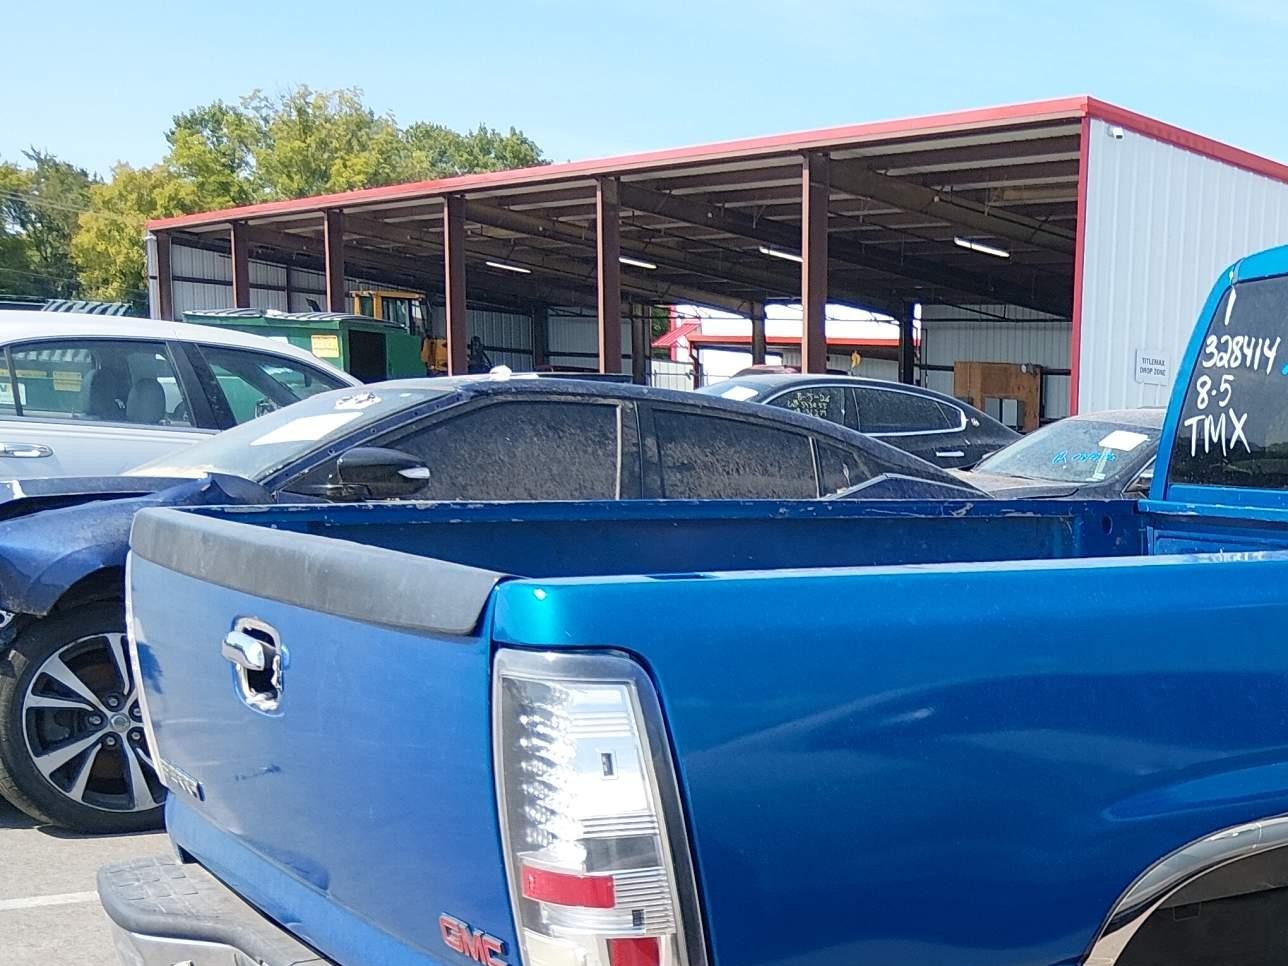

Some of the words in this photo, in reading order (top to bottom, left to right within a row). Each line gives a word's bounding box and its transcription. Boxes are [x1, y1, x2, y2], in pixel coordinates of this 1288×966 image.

[1142, 357, 1165, 366] TITLEMAX
[1202, 334, 1281, 375] 328414
[1140, 366, 1153, 375] DROP
[1154, 368, 1166, 376] ZONE
[1184, 407, 1251, 457] TMX
